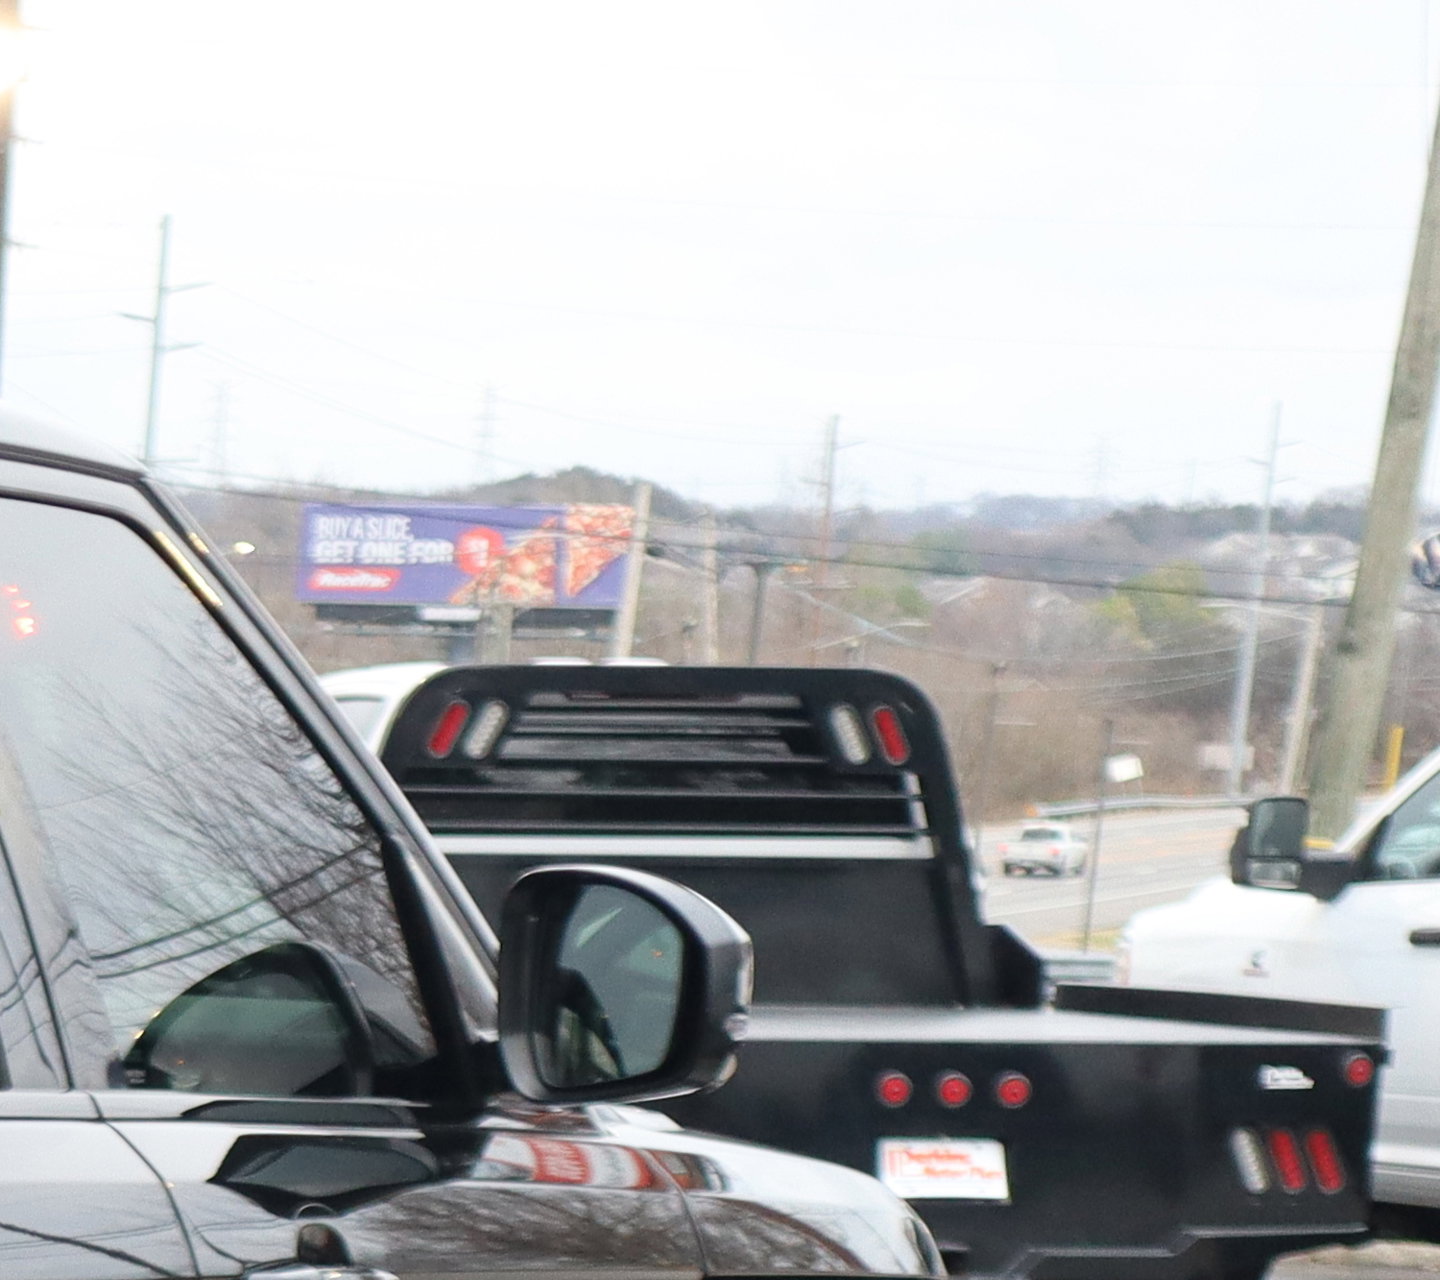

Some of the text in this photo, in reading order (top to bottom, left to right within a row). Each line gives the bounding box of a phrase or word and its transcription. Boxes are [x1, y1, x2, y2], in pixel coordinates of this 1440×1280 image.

[317, 515, 351, 539] BUY
[351, 516, 364, 539] A
[314, 540, 357, 564] GET
[359, 540, 406, 564] ONE
[408, 540, 454, 564] FOR
